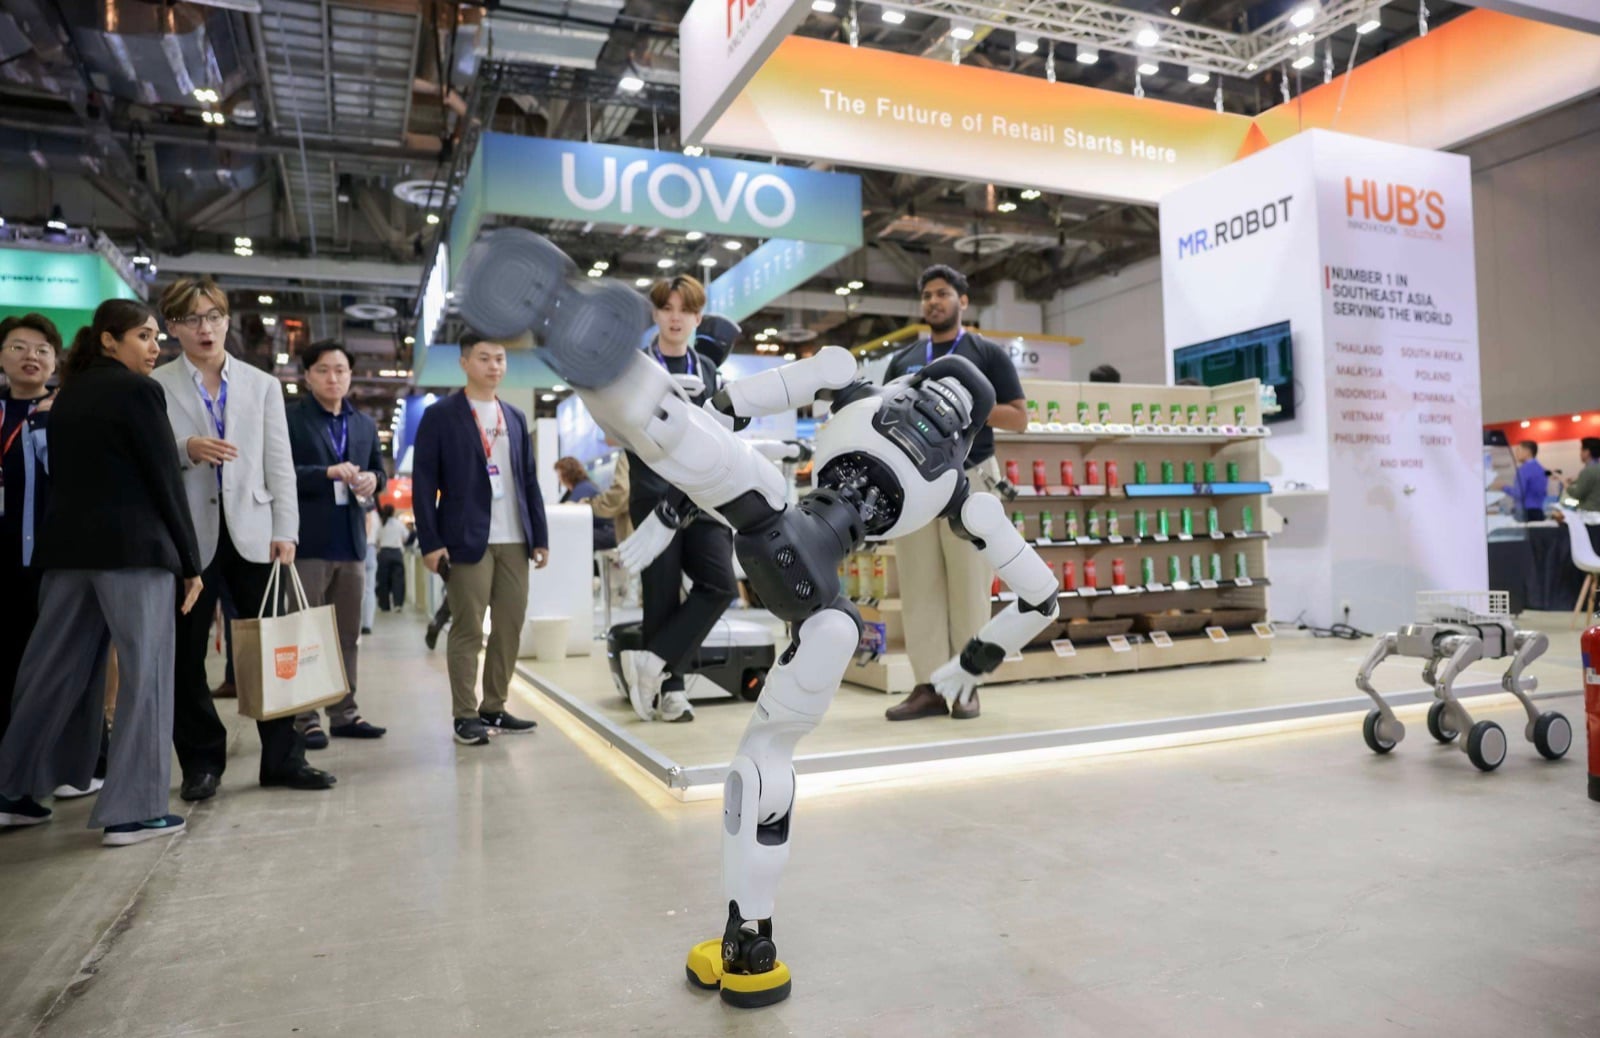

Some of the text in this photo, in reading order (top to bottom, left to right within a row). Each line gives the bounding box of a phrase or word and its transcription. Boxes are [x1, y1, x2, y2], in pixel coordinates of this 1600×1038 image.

[820, 88, 1177, 163] The Future of Retail Starts Here
[1345, 176, 1446, 230] HUB'S
[1178, 195, 1293, 259] MR.ROBOT
[1331, 266, 1408, 287] NUMBER 1 IN
[1332, 284, 1403, 304] SOUTHEAST
[1333, 301, 1453, 326] SERVING THE WORLD
[1335, 342, 1384, 356] THAILAND
[1400, 347, 1463, 361] SOUTH AFRICA
[1336, 365, 1383, 378] MALAYSIA
[1415, 370, 1451, 382] POLAND
[1334, 388, 1387, 400] INDONESIA
[1412, 392, 1455, 403] ROMANIA
[1341, 410, 1384, 422] VIETNAM
[1418, 413, 1452, 424] EUROPE
[1419, 435, 1452, 446] TURKEY
